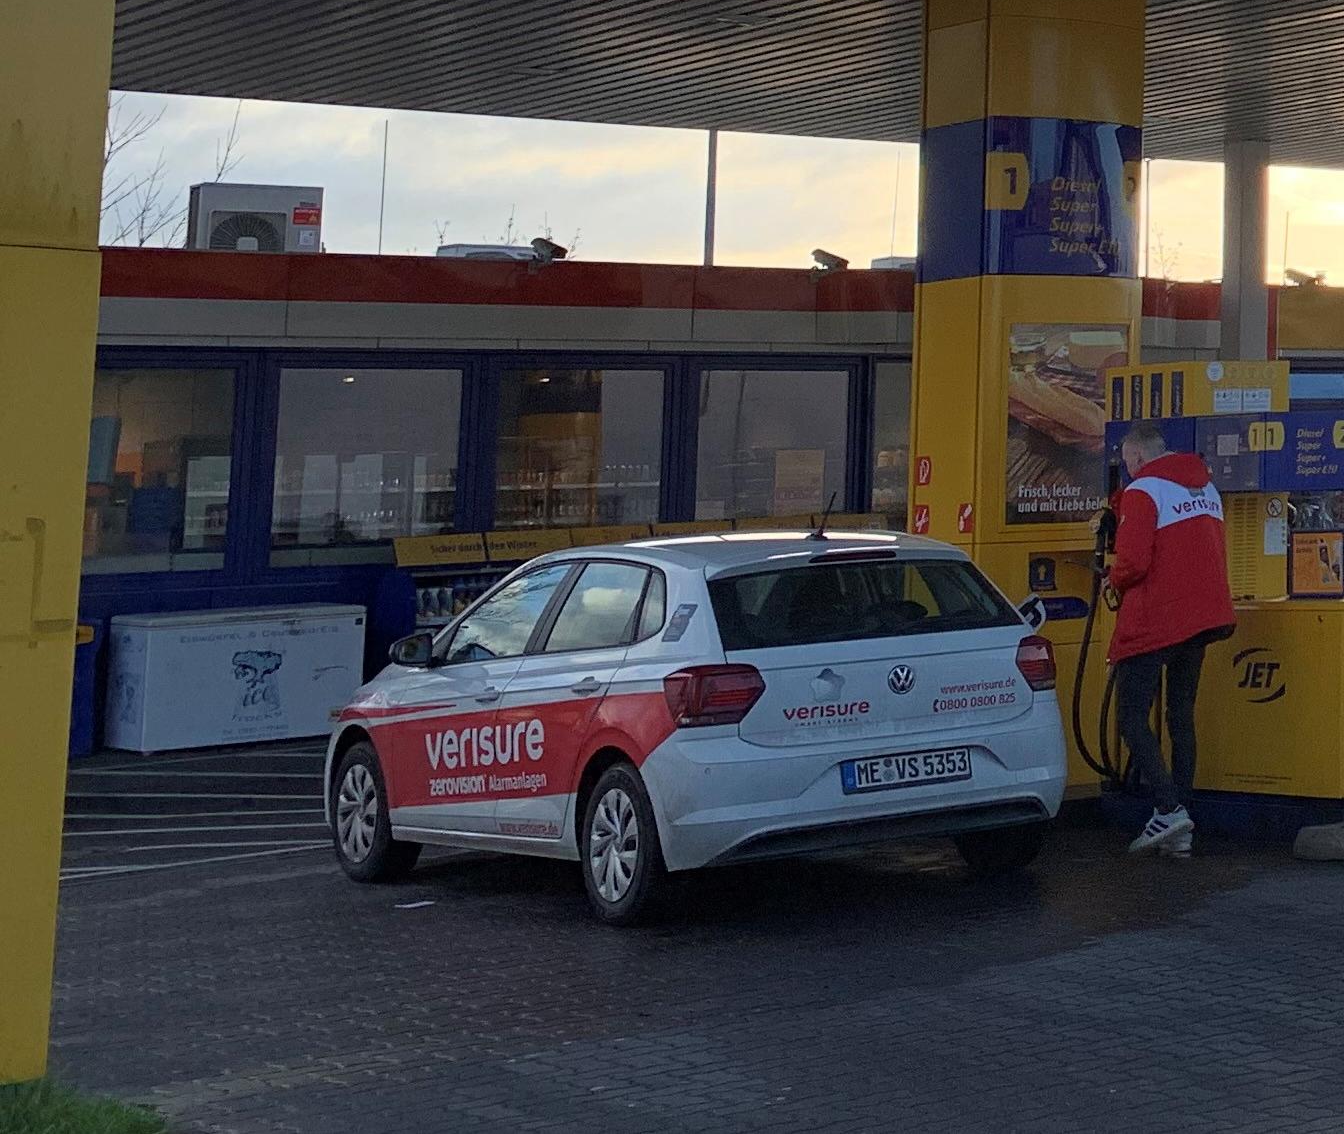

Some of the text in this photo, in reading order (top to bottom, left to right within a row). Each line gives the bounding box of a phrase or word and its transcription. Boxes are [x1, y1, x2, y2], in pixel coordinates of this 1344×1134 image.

[1004, 167, 1017, 195] 1
[1050, 196, 1096, 214] Super
[1050, 237, 1094, 257] Super
[1252, 428, 1258, 446] 1
[1267, 427, 1274, 446] 1
[1018, 483, 1082, 499] Frisch, lecker
[1018, 499, 1038, 514] und
[1040, 498, 1058, 512] mit
[1059, 498, 1084, 512] Liebe
[940, 676, 1017, 695] www.verisure.de
[1238, 662, 1280, 689] JET
[783, 699, 870, 721] verisure
[939, 692, 1017, 712] 0800 0800 825
[425, 718, 545, 771] verisure
[857, 750, 969, 786] ME VS 5353
[488, 771, 547, 793] Alarmanlagen
